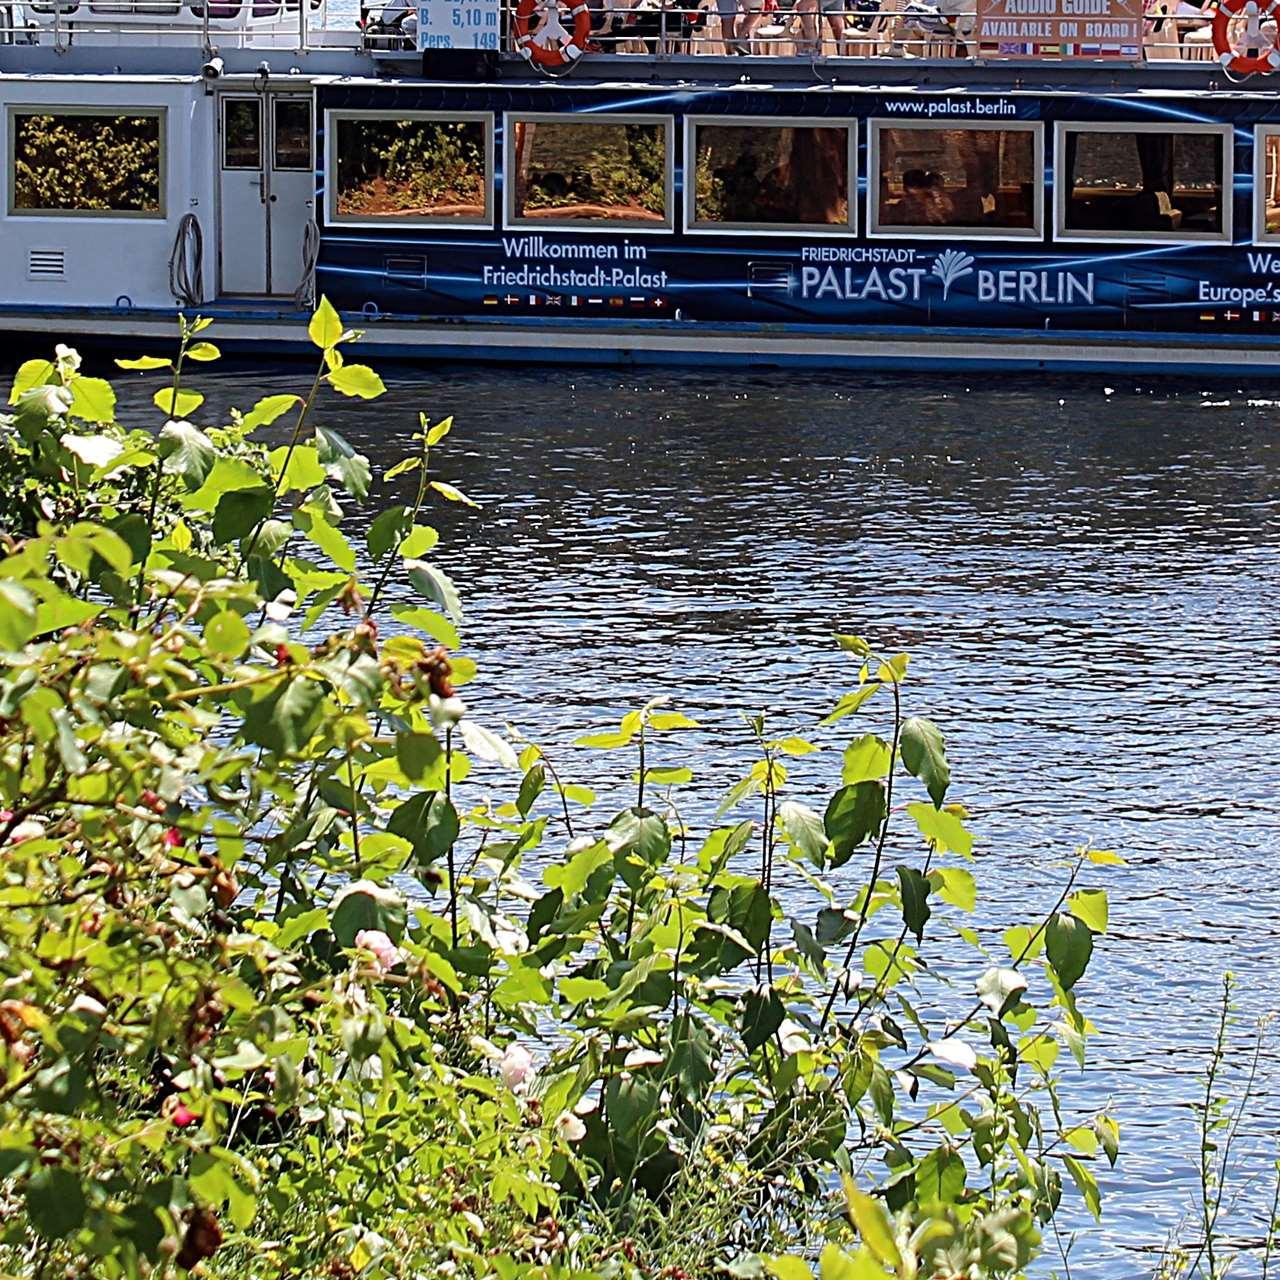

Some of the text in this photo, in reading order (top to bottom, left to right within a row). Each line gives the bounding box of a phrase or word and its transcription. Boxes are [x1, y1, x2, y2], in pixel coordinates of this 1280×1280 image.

[421, 8, 496, 28] B. 5,10 m
[981, 22, 1052, 37] AVAILABLE
[1059, 23, 1078, 37] ON
[421, 32, 497, 49] Pers. 149
[885, 97, 1017, 117] www.palast.berlin
[502, 236, 647, 259] Willkommen im
[483, 264, 668, 288] Friedrichstadt-Palast
[802, 266, 1094, 304] PALAST BERLIN
